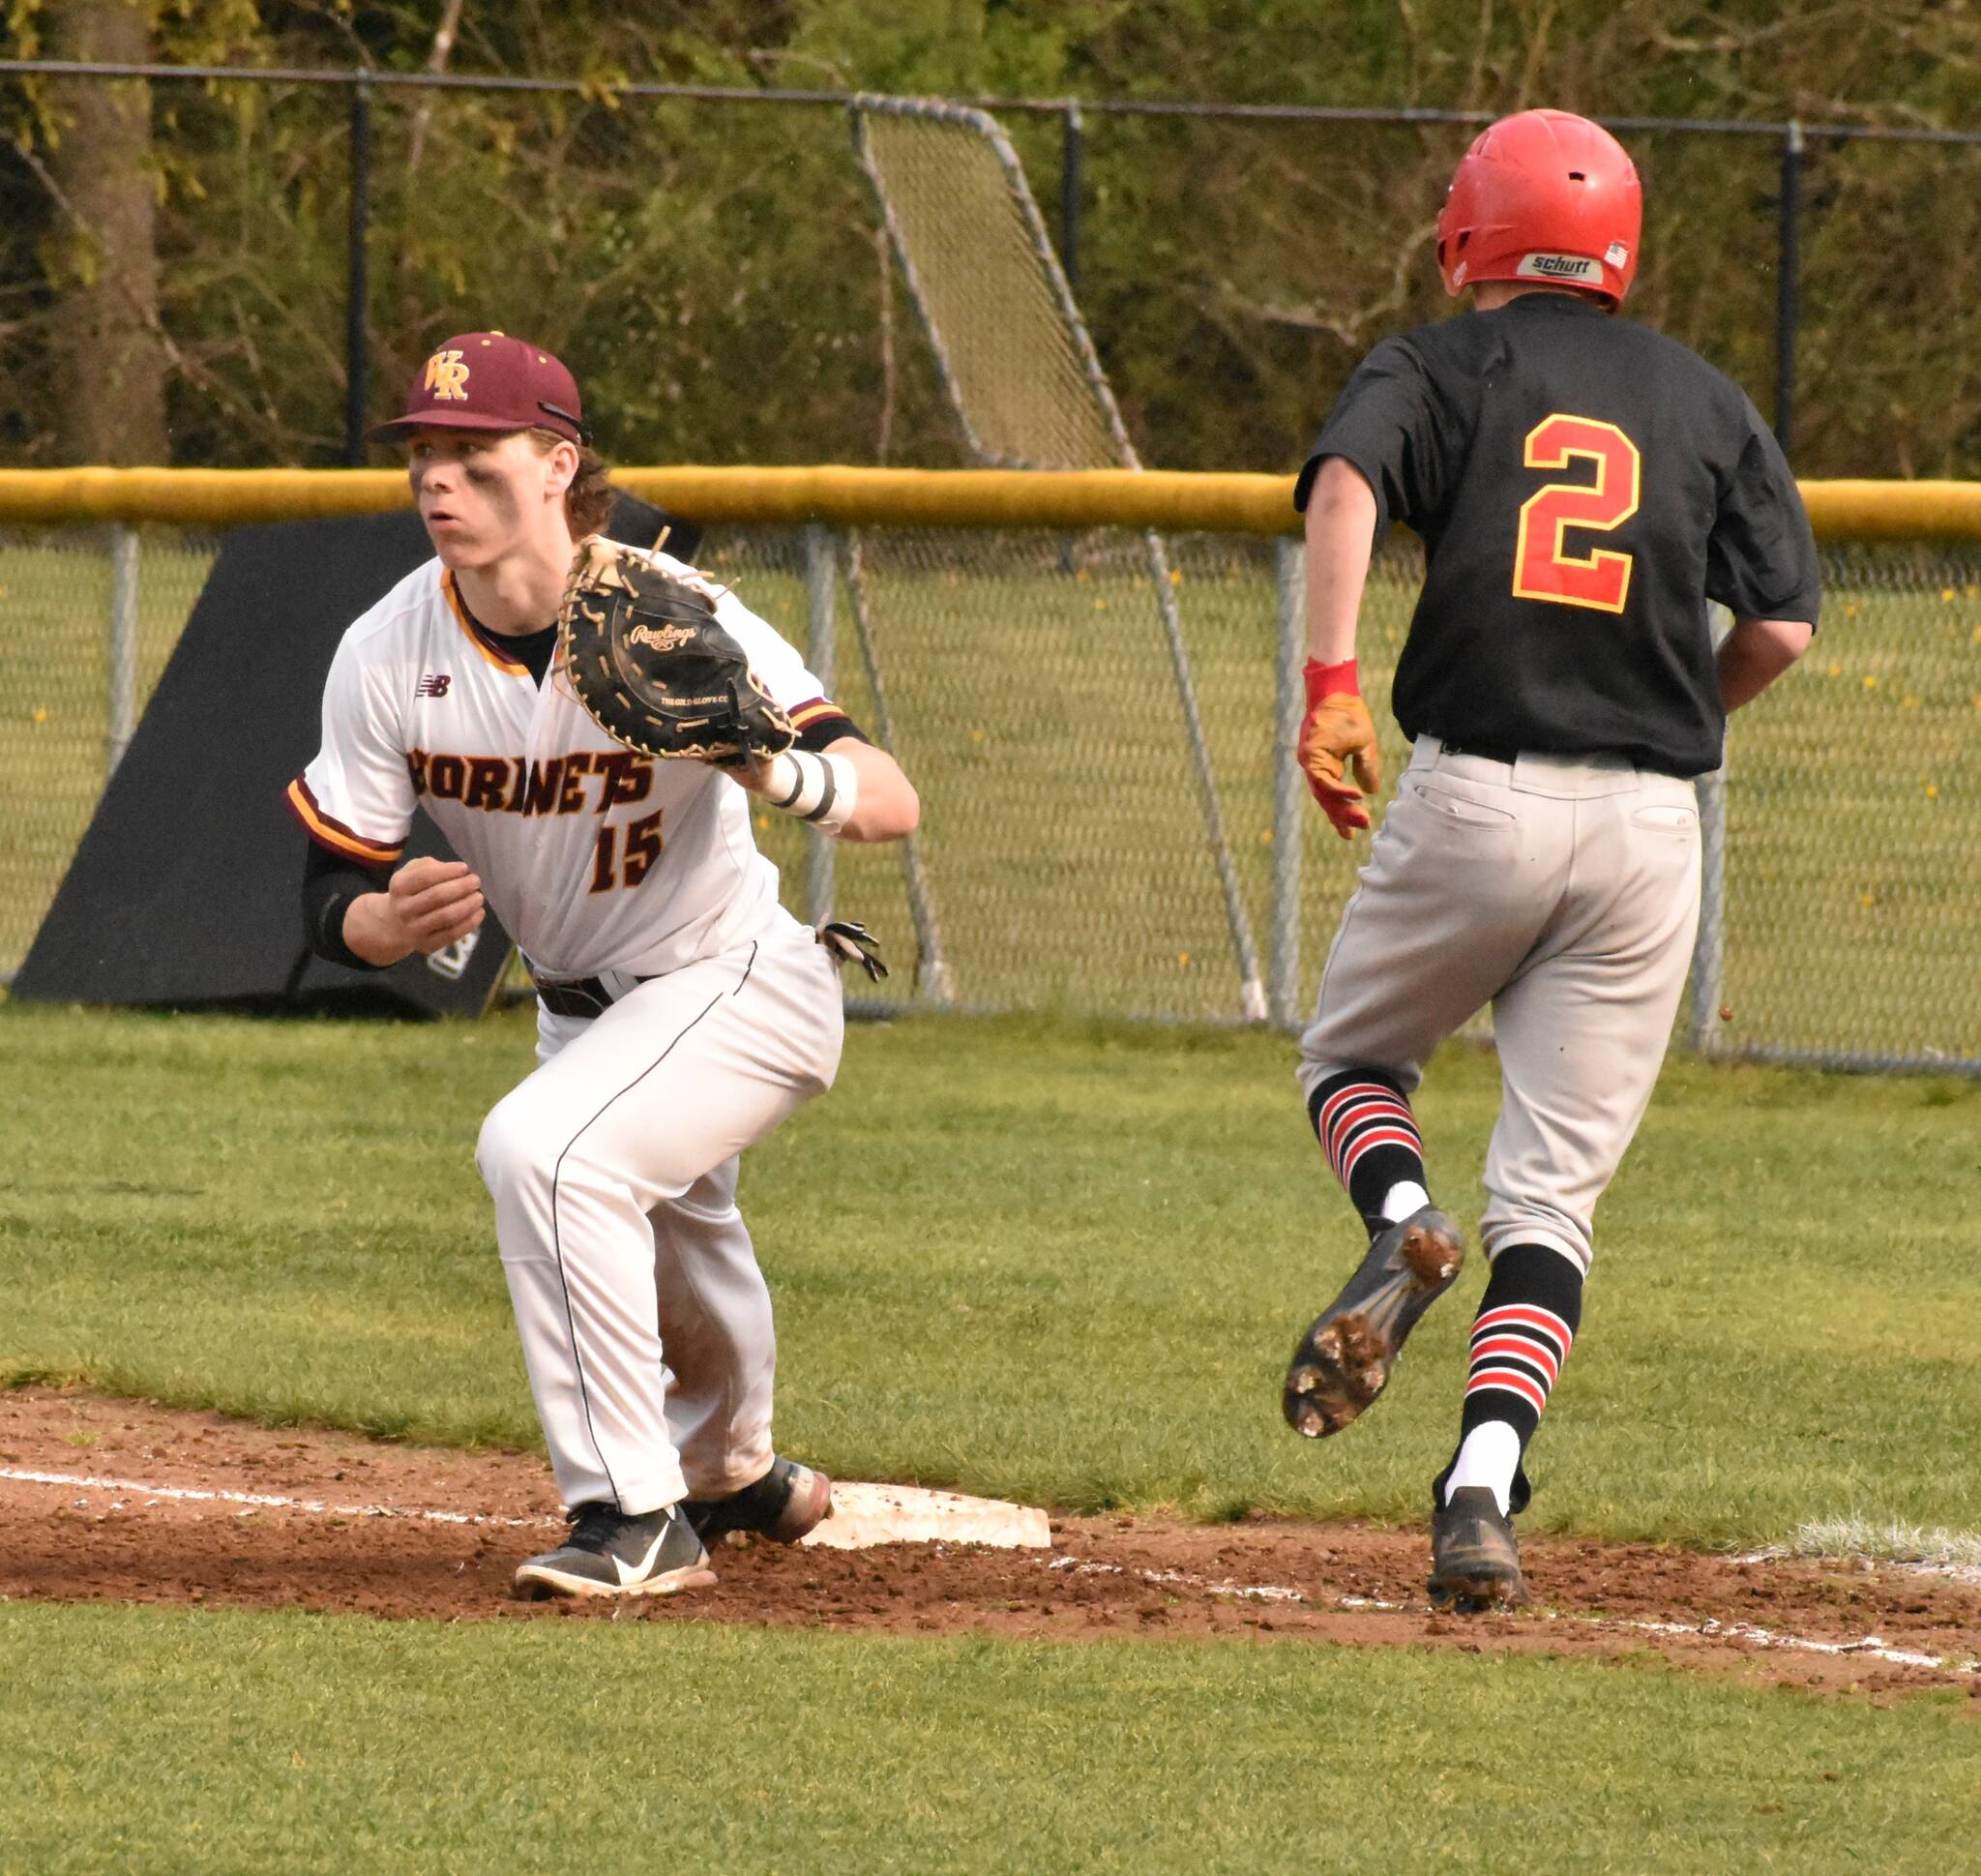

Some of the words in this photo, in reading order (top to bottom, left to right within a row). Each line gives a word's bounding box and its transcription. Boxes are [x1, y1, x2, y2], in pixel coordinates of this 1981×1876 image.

[1532, 254, 1590, 274] schutt
[1512, 413, 1641, 614] 2
[630, 624, 696, 646] Rawlings
[588, 809, 664, 894] 15
